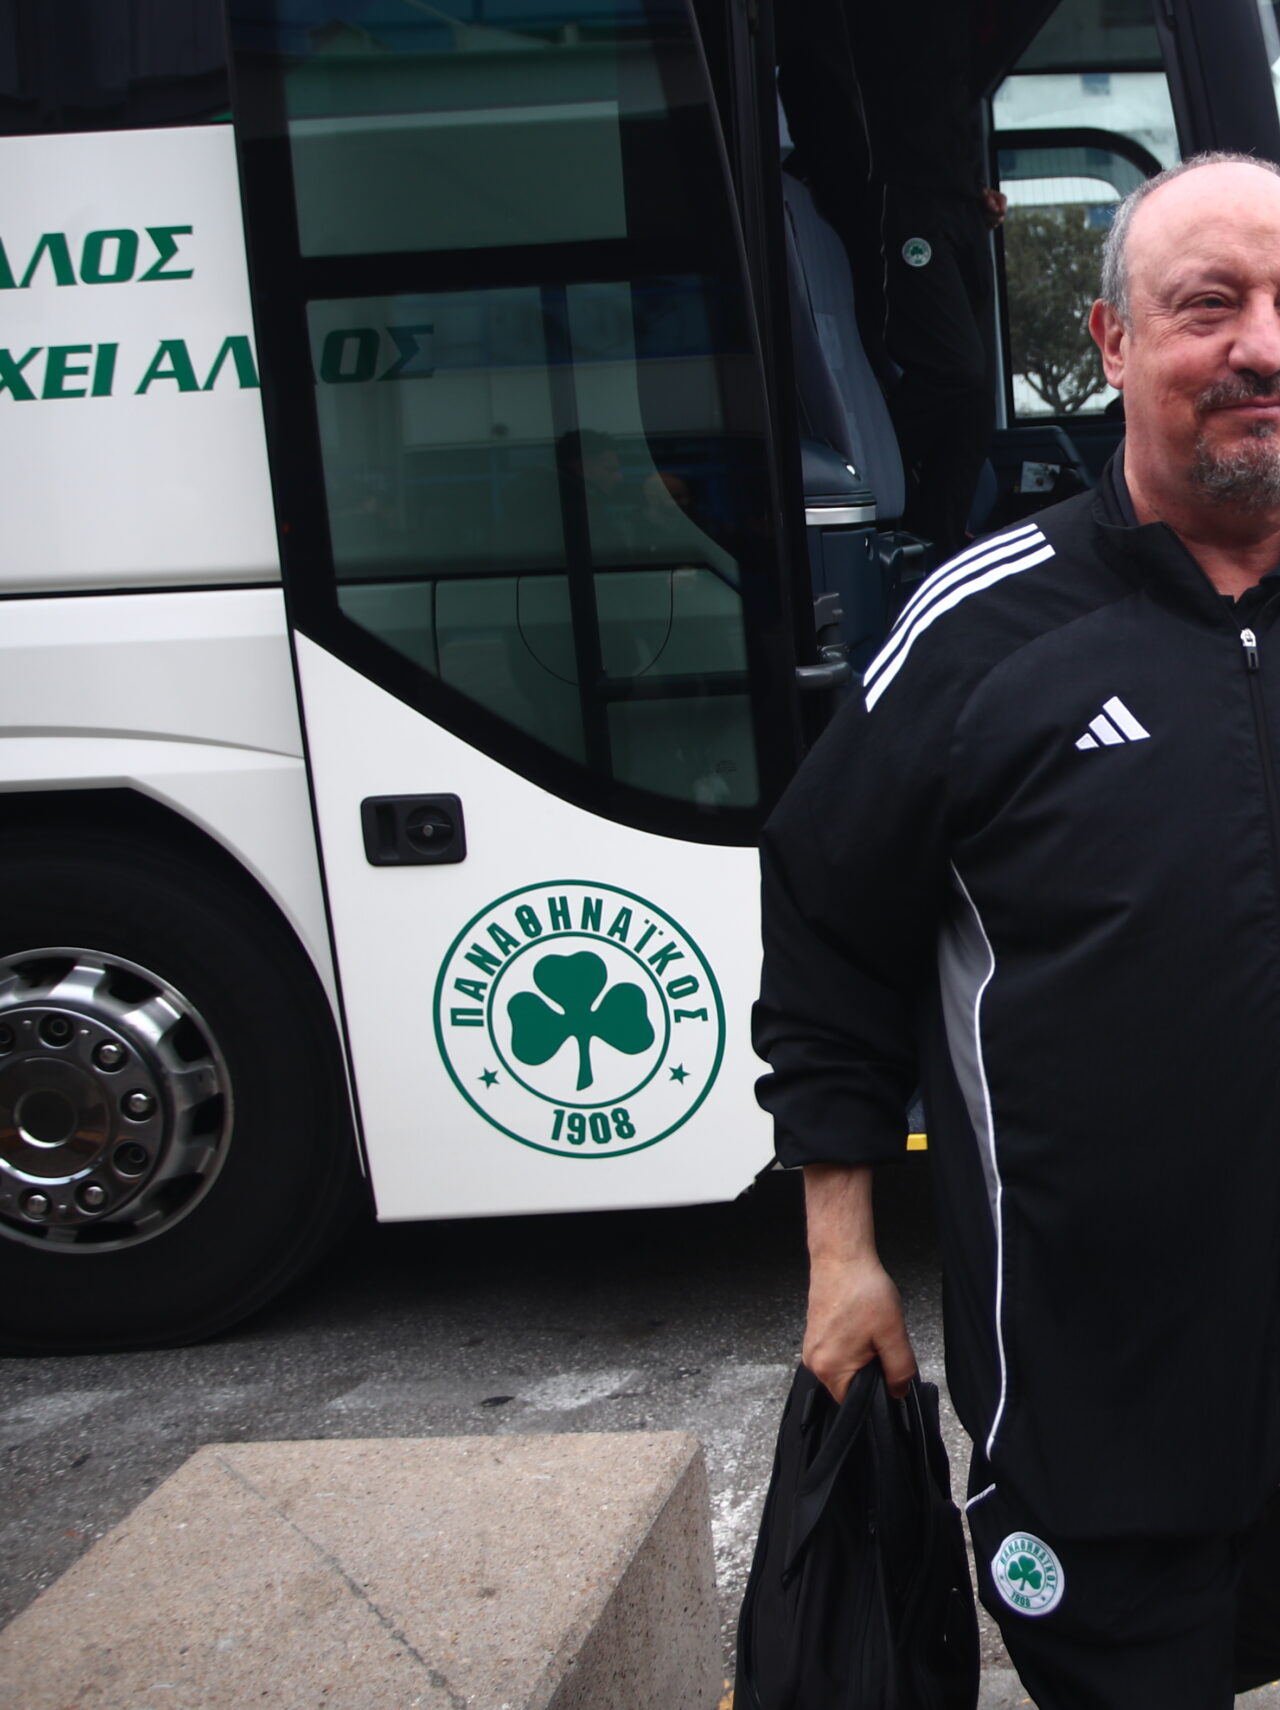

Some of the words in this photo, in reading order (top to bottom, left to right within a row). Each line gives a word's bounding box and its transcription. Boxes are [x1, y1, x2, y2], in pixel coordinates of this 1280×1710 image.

[134, 323, 436, 395] ΑΛΟΣ
[450, 896, 708, 1027] ΠΑΝΑΘΗΝΑΪΚΟΣ
[551, 1107, 636, 1146] 1908
